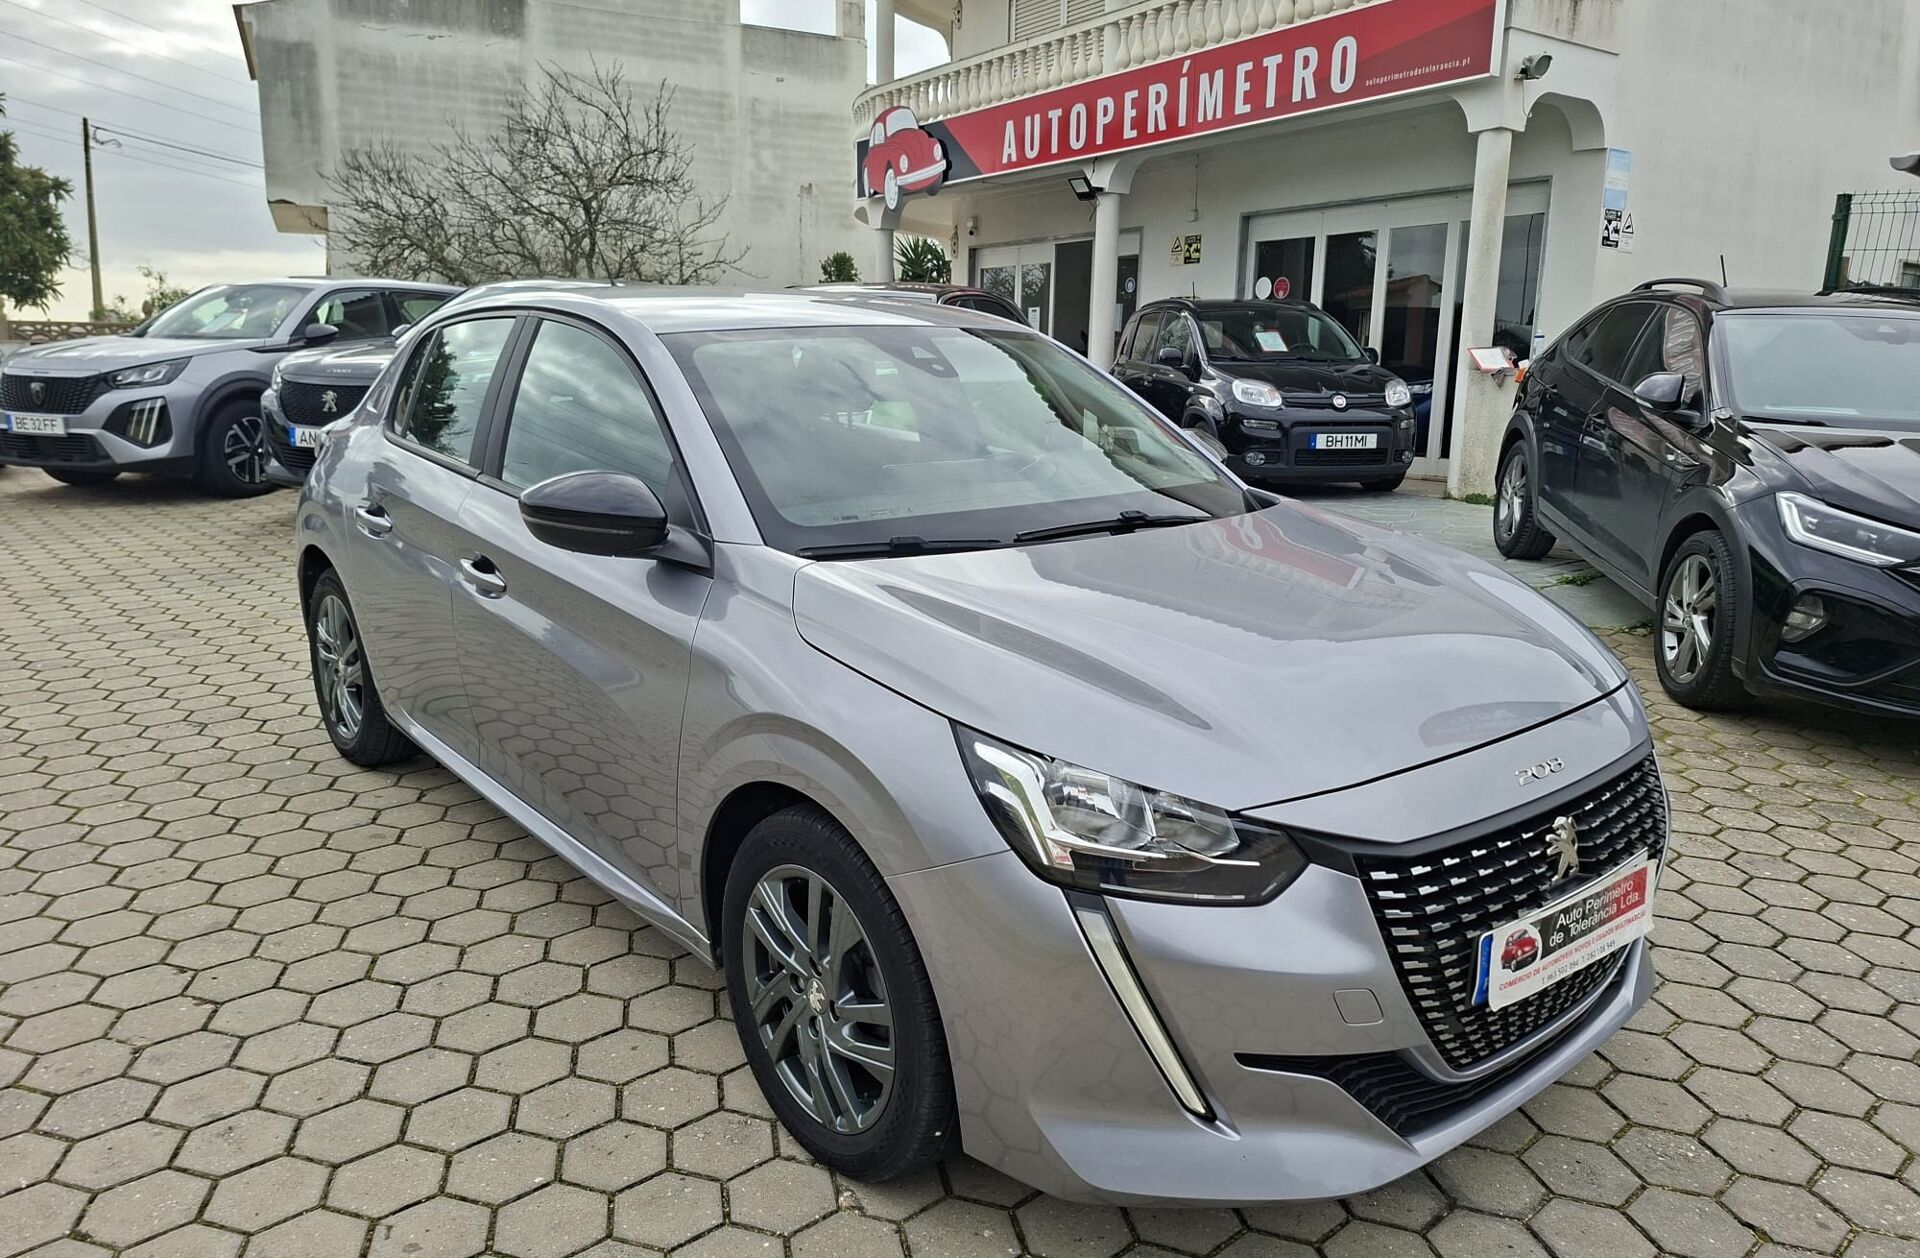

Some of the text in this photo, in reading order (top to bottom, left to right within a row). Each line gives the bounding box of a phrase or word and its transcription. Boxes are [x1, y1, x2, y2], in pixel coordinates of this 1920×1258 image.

[1365, 57, 1471, 87] autoperimetrodetolerancia.pt
[1001, 36, 1358, 164] AUTOPERÍMETRO
[15, 416, 57, 432] BE32FF
[1326, 435, 1367, 447] BH11MI
[1515, 757, 1565, 786] 208
[1549, 931, 1565, 947] de
[1568, 904, 1617, 937] Tolerância
[1556, 907, 1583, 929] Auto
